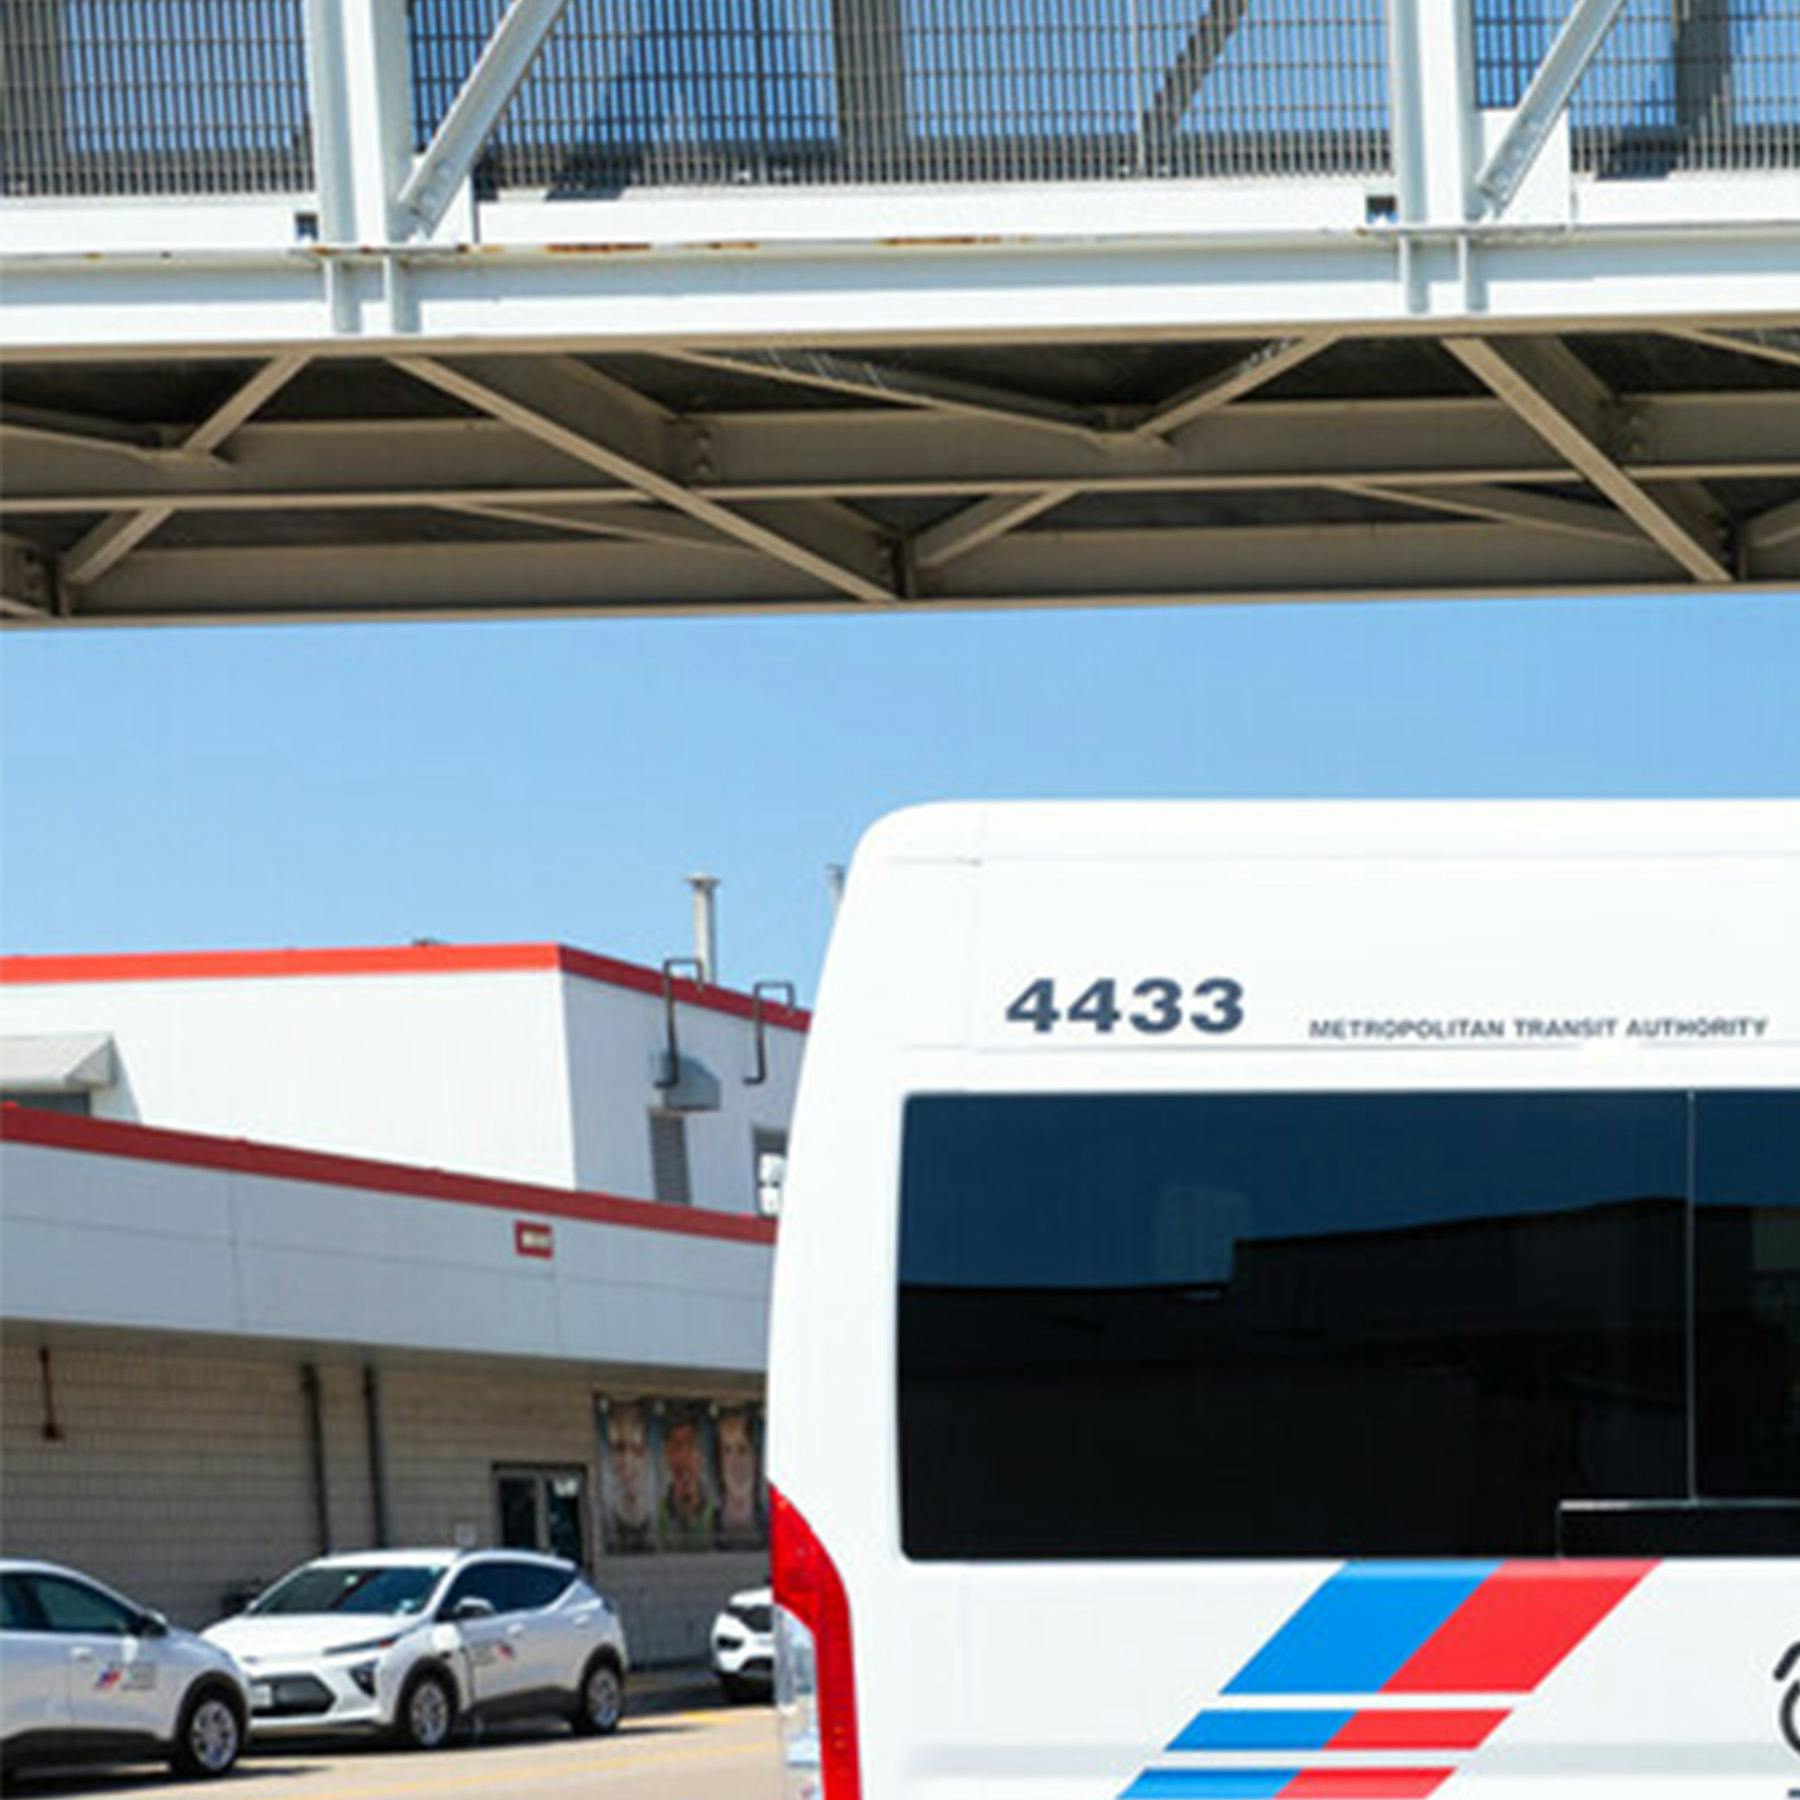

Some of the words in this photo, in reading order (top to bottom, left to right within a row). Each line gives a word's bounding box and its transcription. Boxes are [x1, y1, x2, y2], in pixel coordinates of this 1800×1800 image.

[1005, 976, 1245, 1035] 4433
[1308, 1017, 1505, 1040] METROPOLITAN
[1512, 1017, 1617, 1039] TRANSIT
[1625, 1016, 1770, 1038] AUTHORITY
